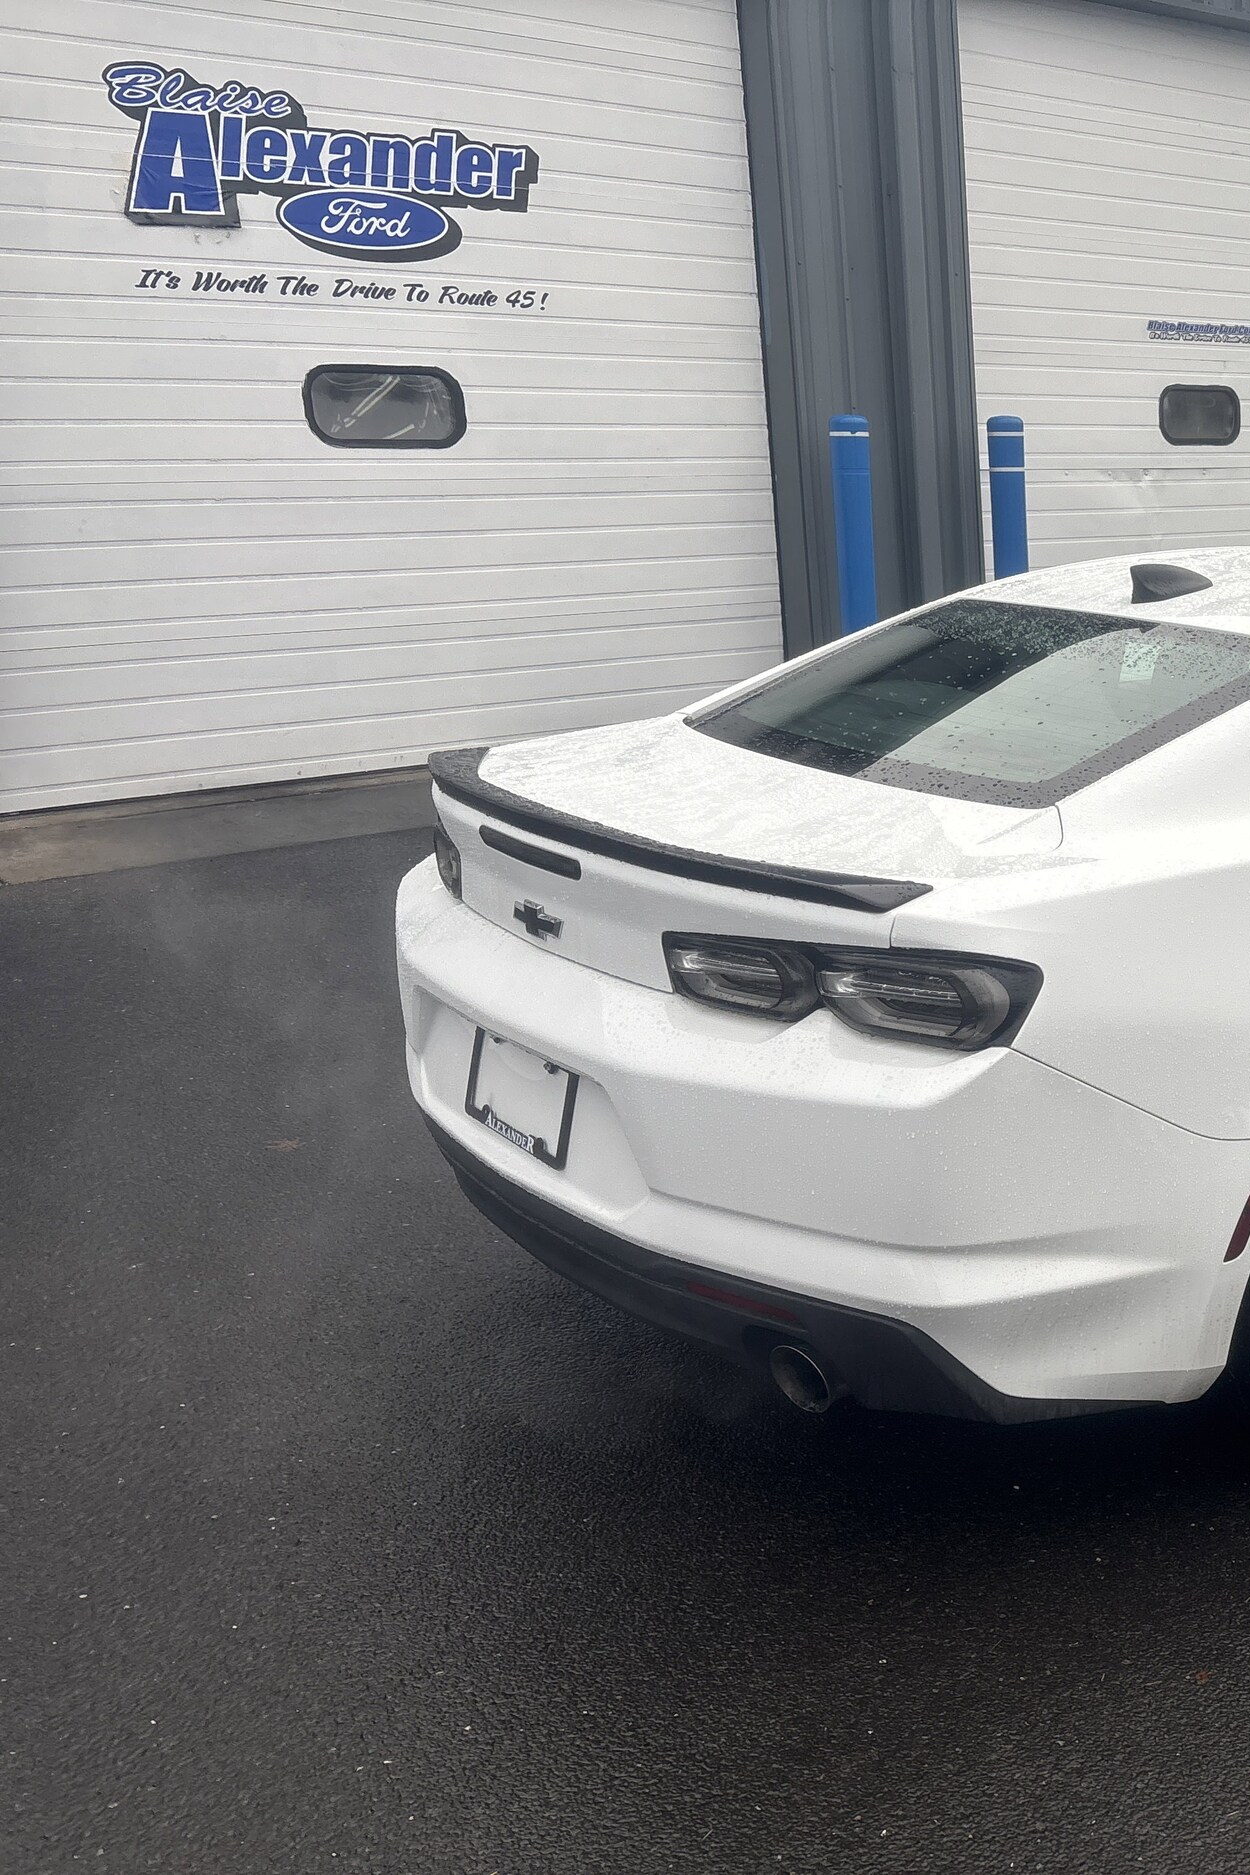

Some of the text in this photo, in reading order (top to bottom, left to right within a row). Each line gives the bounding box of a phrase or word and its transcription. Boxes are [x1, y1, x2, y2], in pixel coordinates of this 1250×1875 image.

[106, 65, 293, 118] Blaise
[129, 107, 527, 215] Alexander
[320, 197, 411, 236] Ford
[135, 269, 181, 289] It's
[191, 271, 269, 294] Worth
[277, 275, 320, 297] The
[331, 278, 397, 301] Drive
[403, 283, 430, 303] To
[438, 285, 498, 307] Route
[485, 1111, 535, 1155] ALEXANDER
